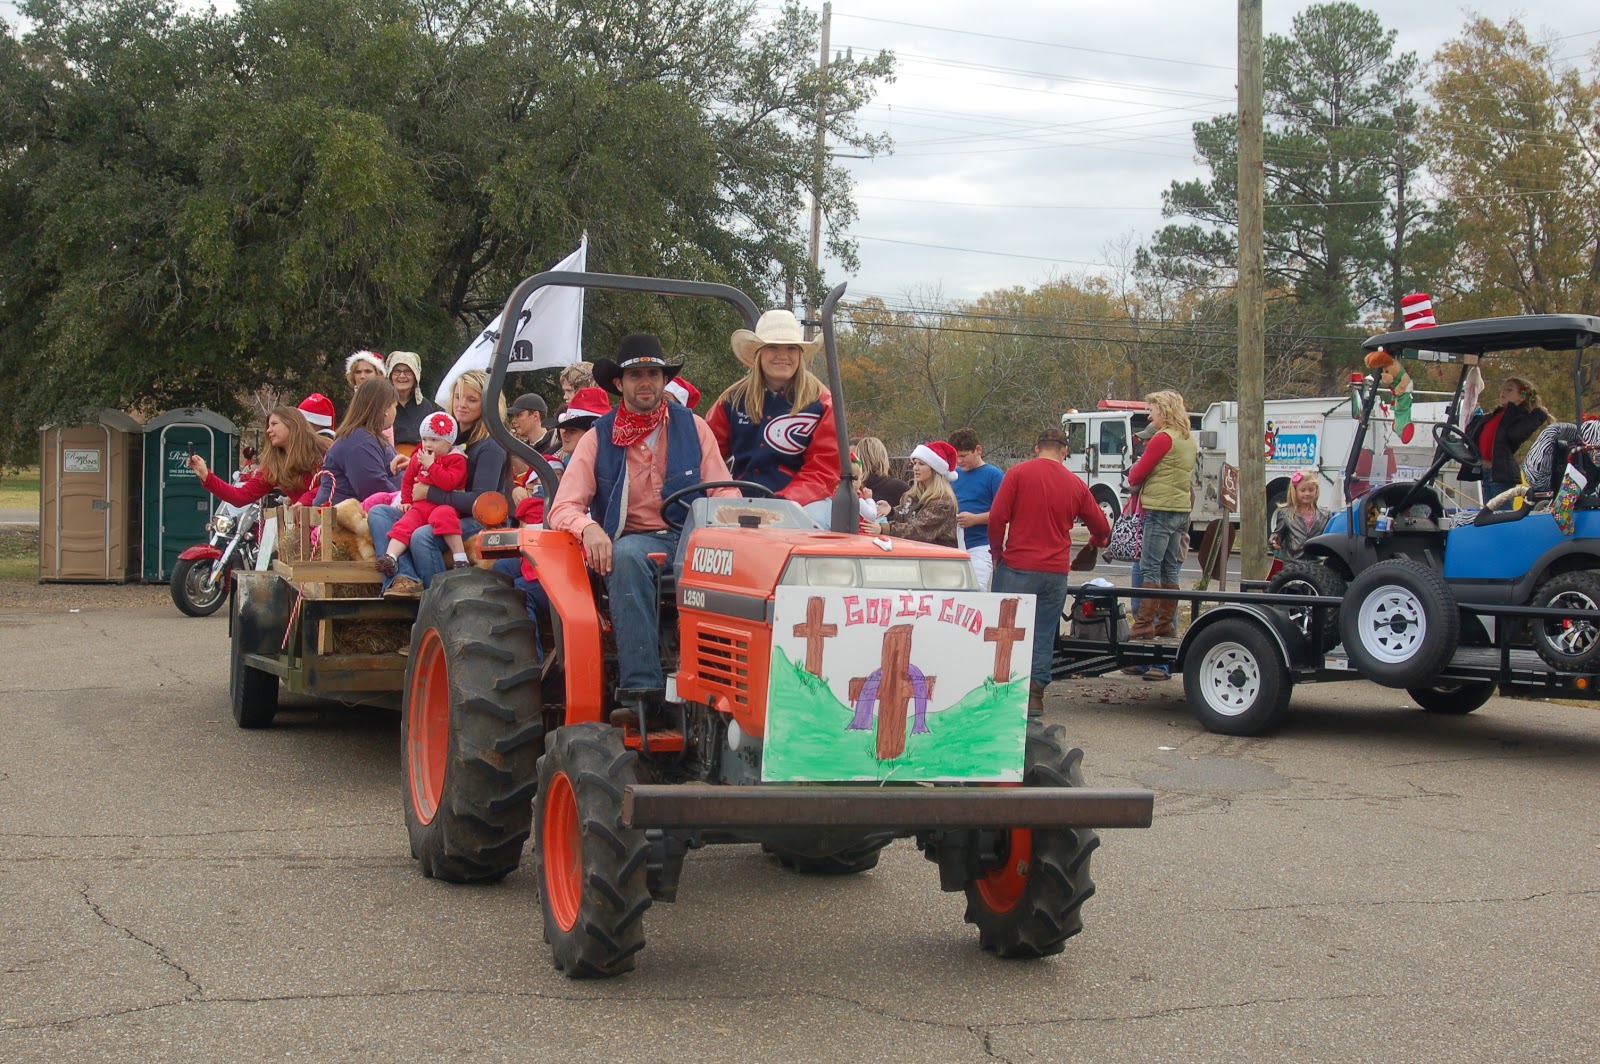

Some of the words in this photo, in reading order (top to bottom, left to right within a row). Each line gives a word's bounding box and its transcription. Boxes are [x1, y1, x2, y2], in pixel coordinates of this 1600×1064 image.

[691, 546, 734, 577] KUBOTA
[683, 589, 705, 608] L2500
[843, 595, 892, 627] GOD
[896, 595, 934, 619] IS
[937, 597, 983, 635] GOOD
